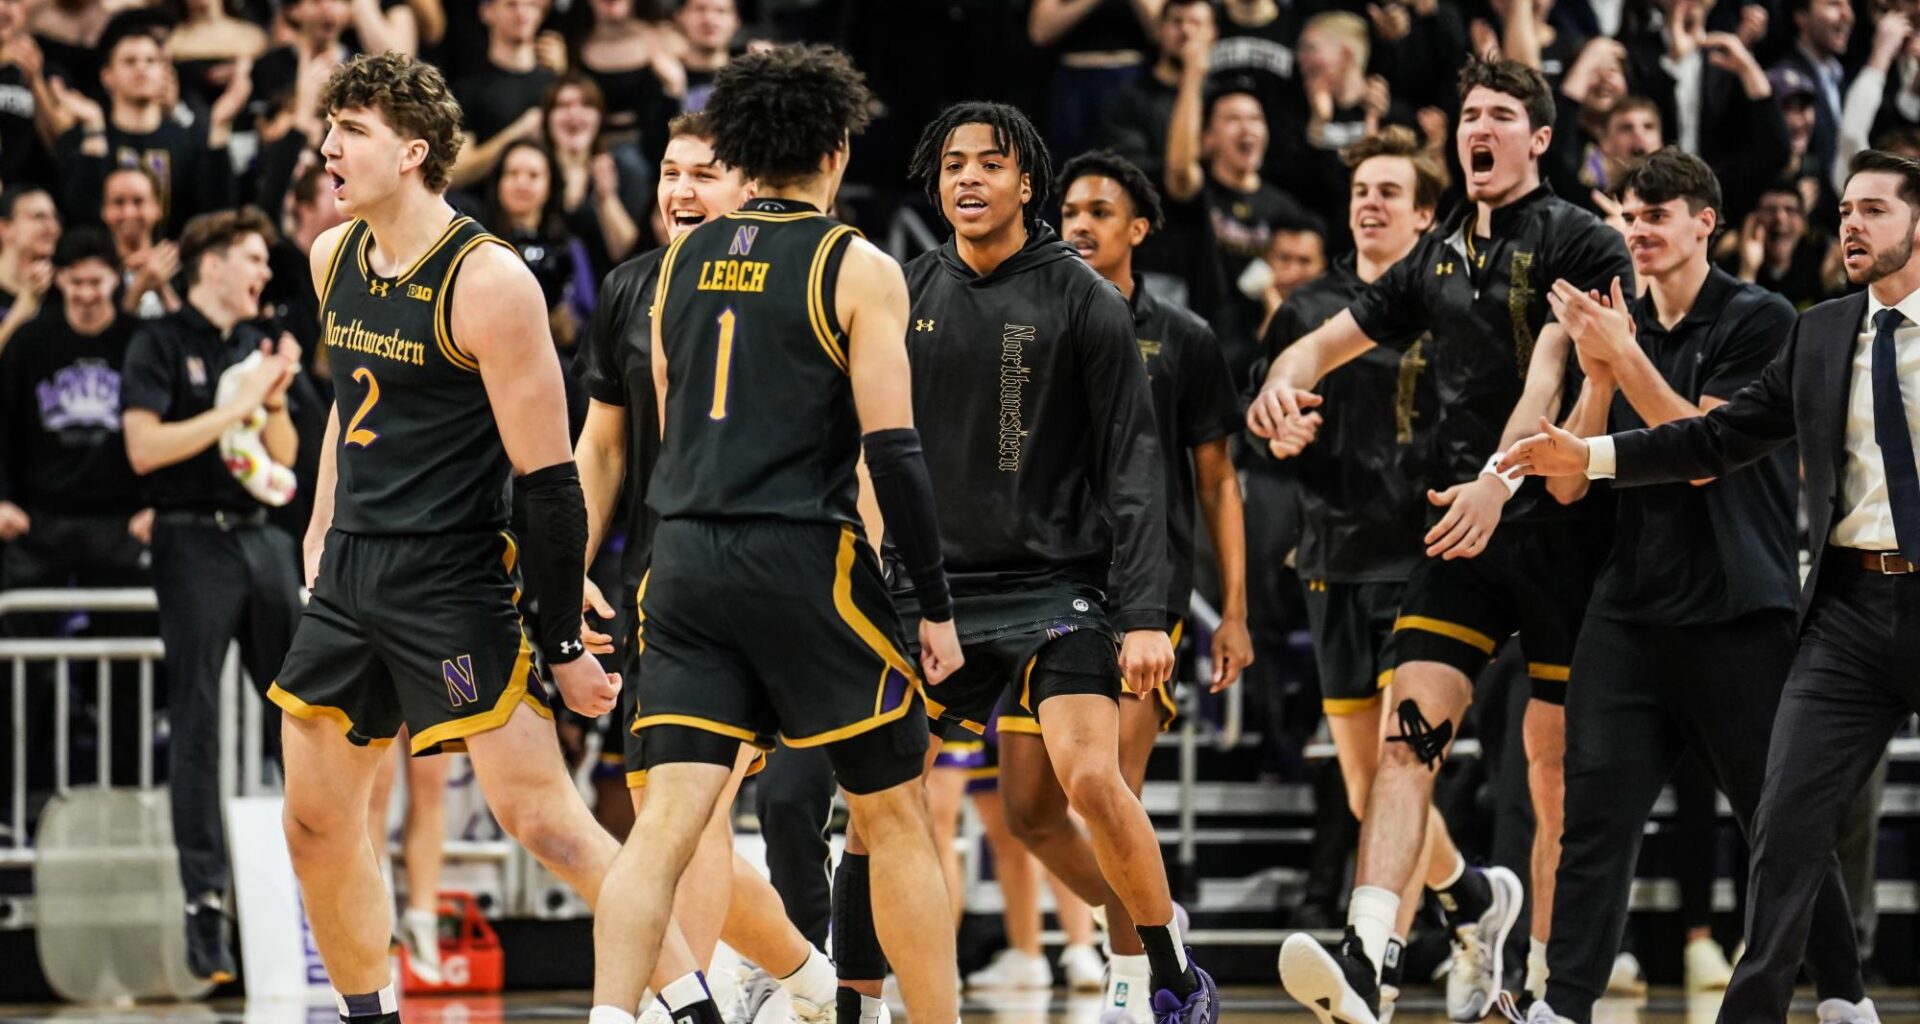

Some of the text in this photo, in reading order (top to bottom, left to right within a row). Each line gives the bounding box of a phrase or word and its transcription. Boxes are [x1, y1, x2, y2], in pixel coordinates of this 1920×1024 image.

[728, 225, 759, 256] N
[697, 260, 770, 292] LEACH
[325, 310, 425, 367] Northwestern
[708, 307, 736, 421] 1
[344, 366, 380, 448] 2
[998, 322, 1036, 472] Northwestern
[442, 654, 478, 707] N
